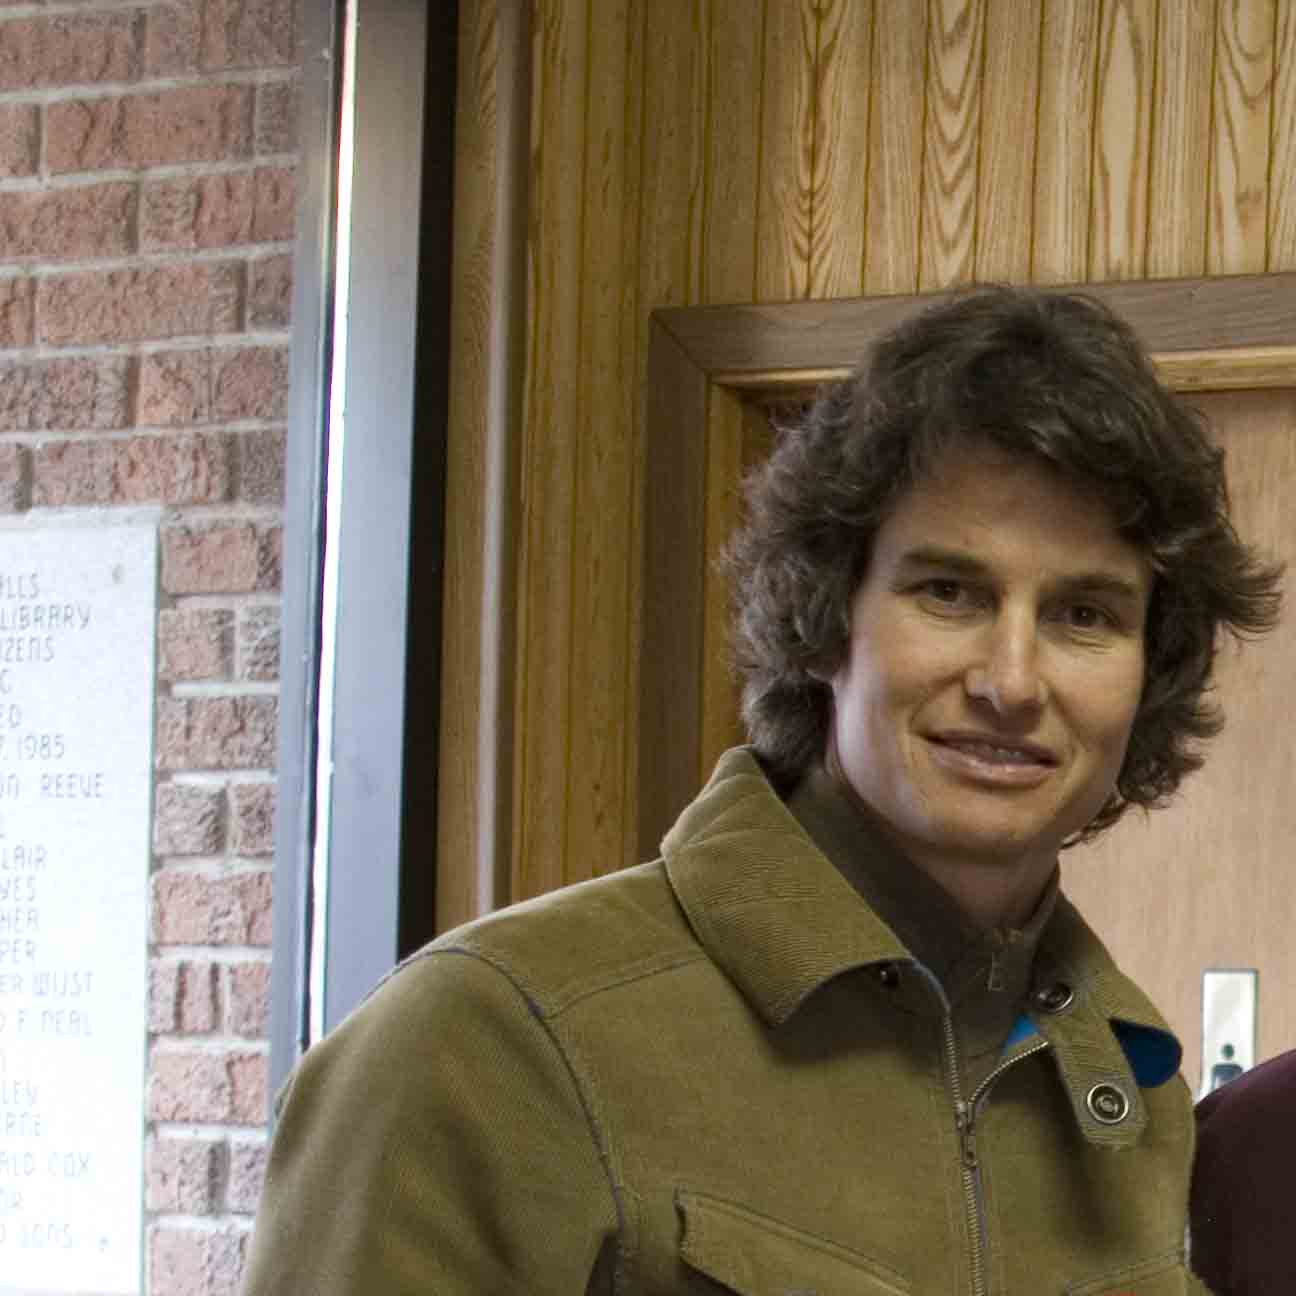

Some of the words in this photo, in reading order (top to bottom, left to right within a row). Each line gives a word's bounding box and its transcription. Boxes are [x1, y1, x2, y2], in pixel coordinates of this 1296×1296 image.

[0, 604, 91, 630] LIBRARY
[18, 734, 65, 760] 1985
[41, 773, 104, 799] REEVE
